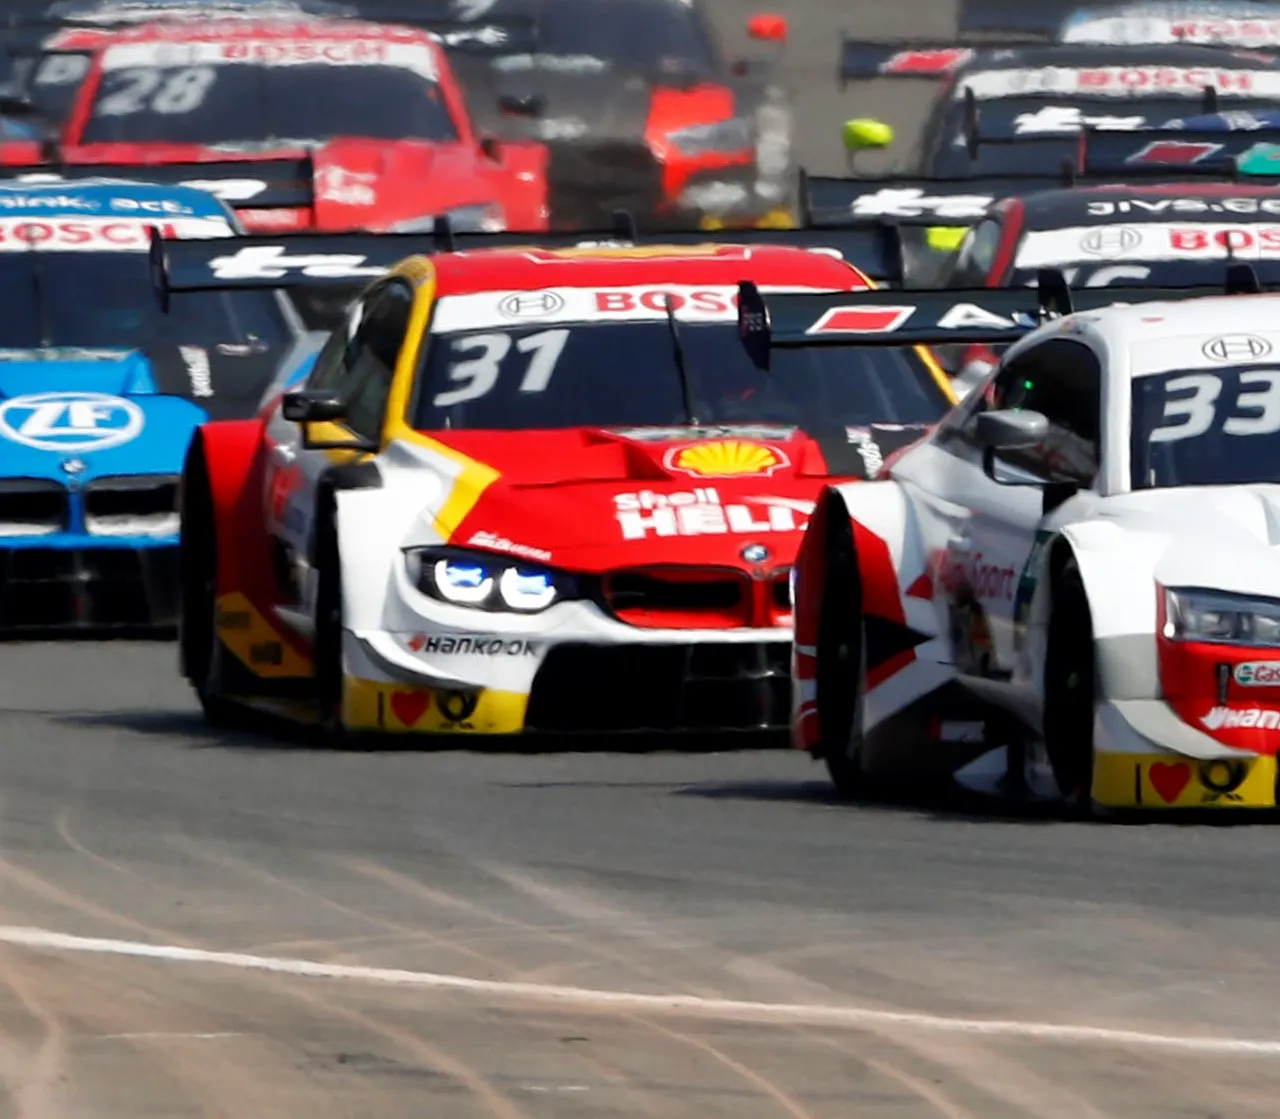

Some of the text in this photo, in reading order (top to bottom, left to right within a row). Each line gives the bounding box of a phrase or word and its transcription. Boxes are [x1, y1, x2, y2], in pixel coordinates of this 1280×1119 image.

[219, 43, 390, 63] BOSCH
[98, 66, 216, 116] 28
[1078, 68, 1253, 90] BOSCH
[594, 291, 740, 313] BOS
[433, 329, 571, 407] 31
[18, 402, 113, 437] ZF
[613, 487, 720, 511] Shell
[616, 503, 808, 541] HELI
